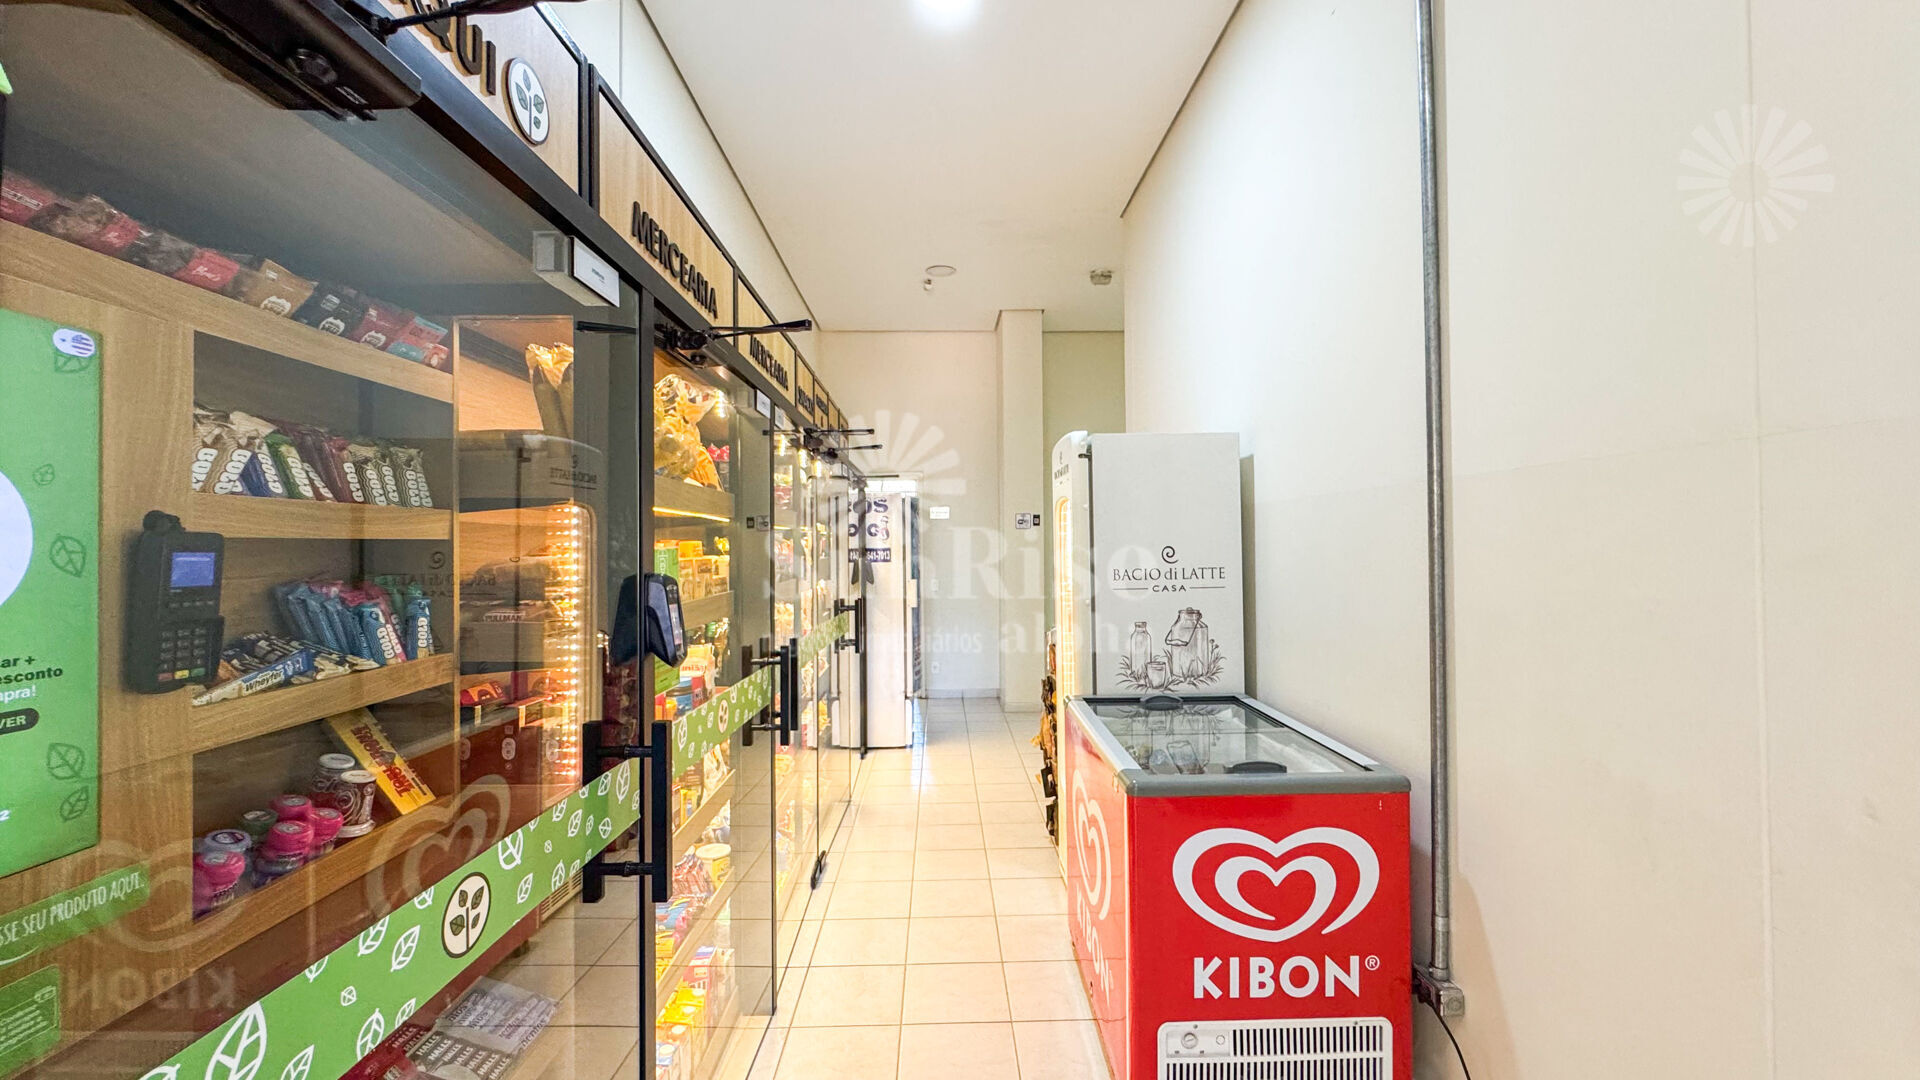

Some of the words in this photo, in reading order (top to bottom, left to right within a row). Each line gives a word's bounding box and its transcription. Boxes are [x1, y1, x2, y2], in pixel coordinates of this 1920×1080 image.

[408, 0, 496, 95] QUI
[632, 201, 718, 319] MERCEARIA
[750, 334, 789, 391] MERCEARIA
[1113, 568, 1160, 581] BACIO
[1164, 568, 1178, 580] di
[1182, 567, 1226, 580] LATTE
[0, 667, 63, 685] sconto
[22, 909, 47, 937] SEU
[50, 886, 107, 926] PRODUTO
[1194, 955, 1360, 999] KIBON
[417, 1034, 440, 1056] HALLS
[429, 1038, 452, 1061] HALLS
[477, 1053, 499, 1076] HALLS
